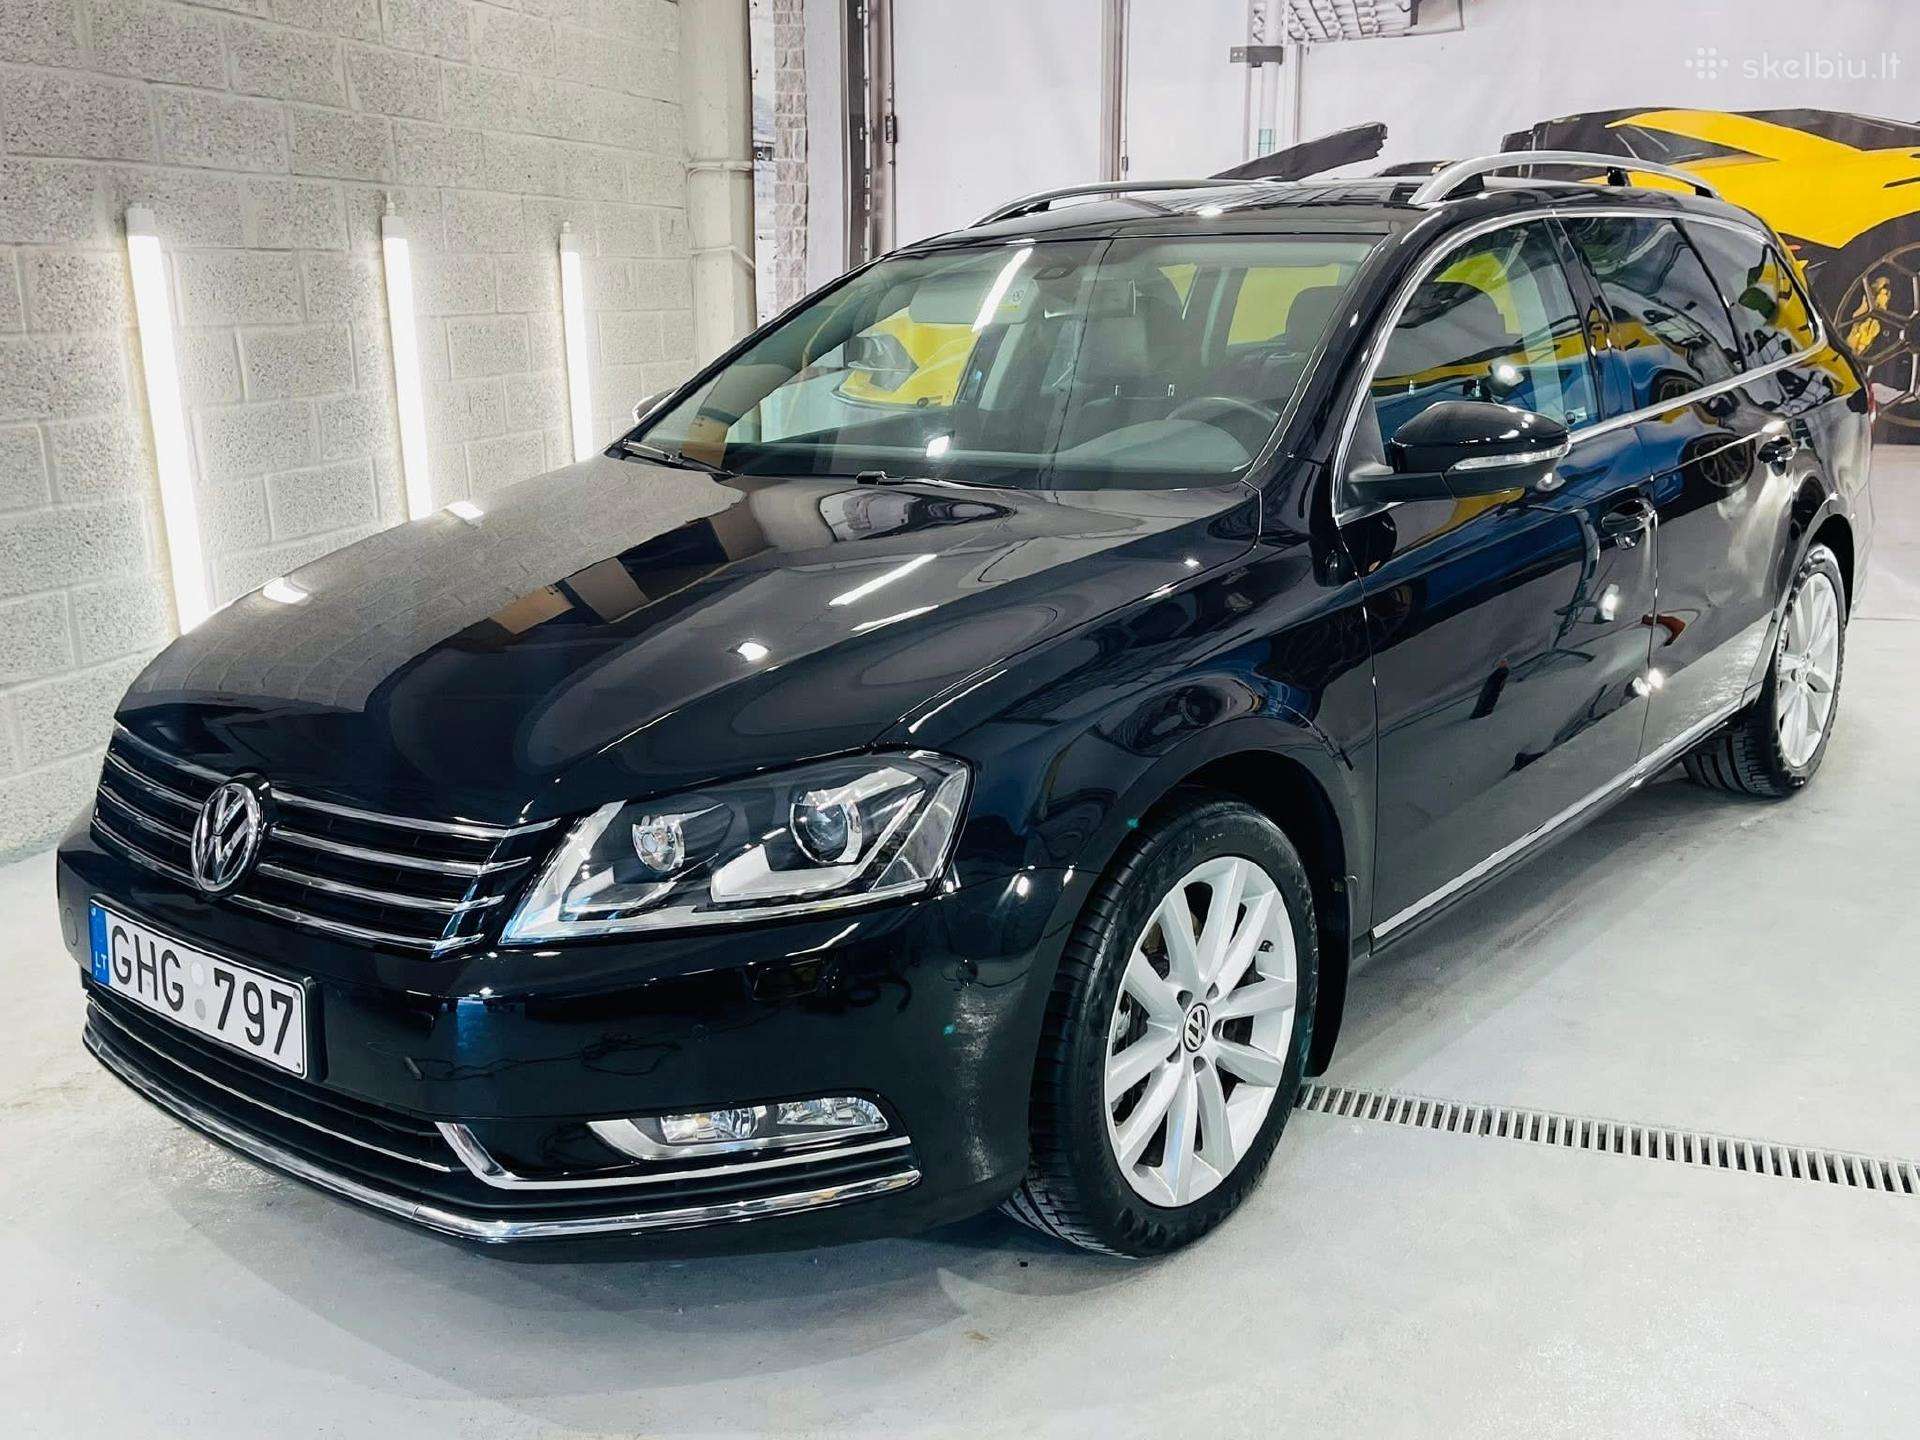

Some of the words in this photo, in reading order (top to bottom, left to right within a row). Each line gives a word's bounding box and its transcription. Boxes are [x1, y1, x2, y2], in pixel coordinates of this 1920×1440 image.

[95, 953, 107, 968] LT
[111, 925, 184, 1011] GHG
[214, 967, 293, 1055] 797
